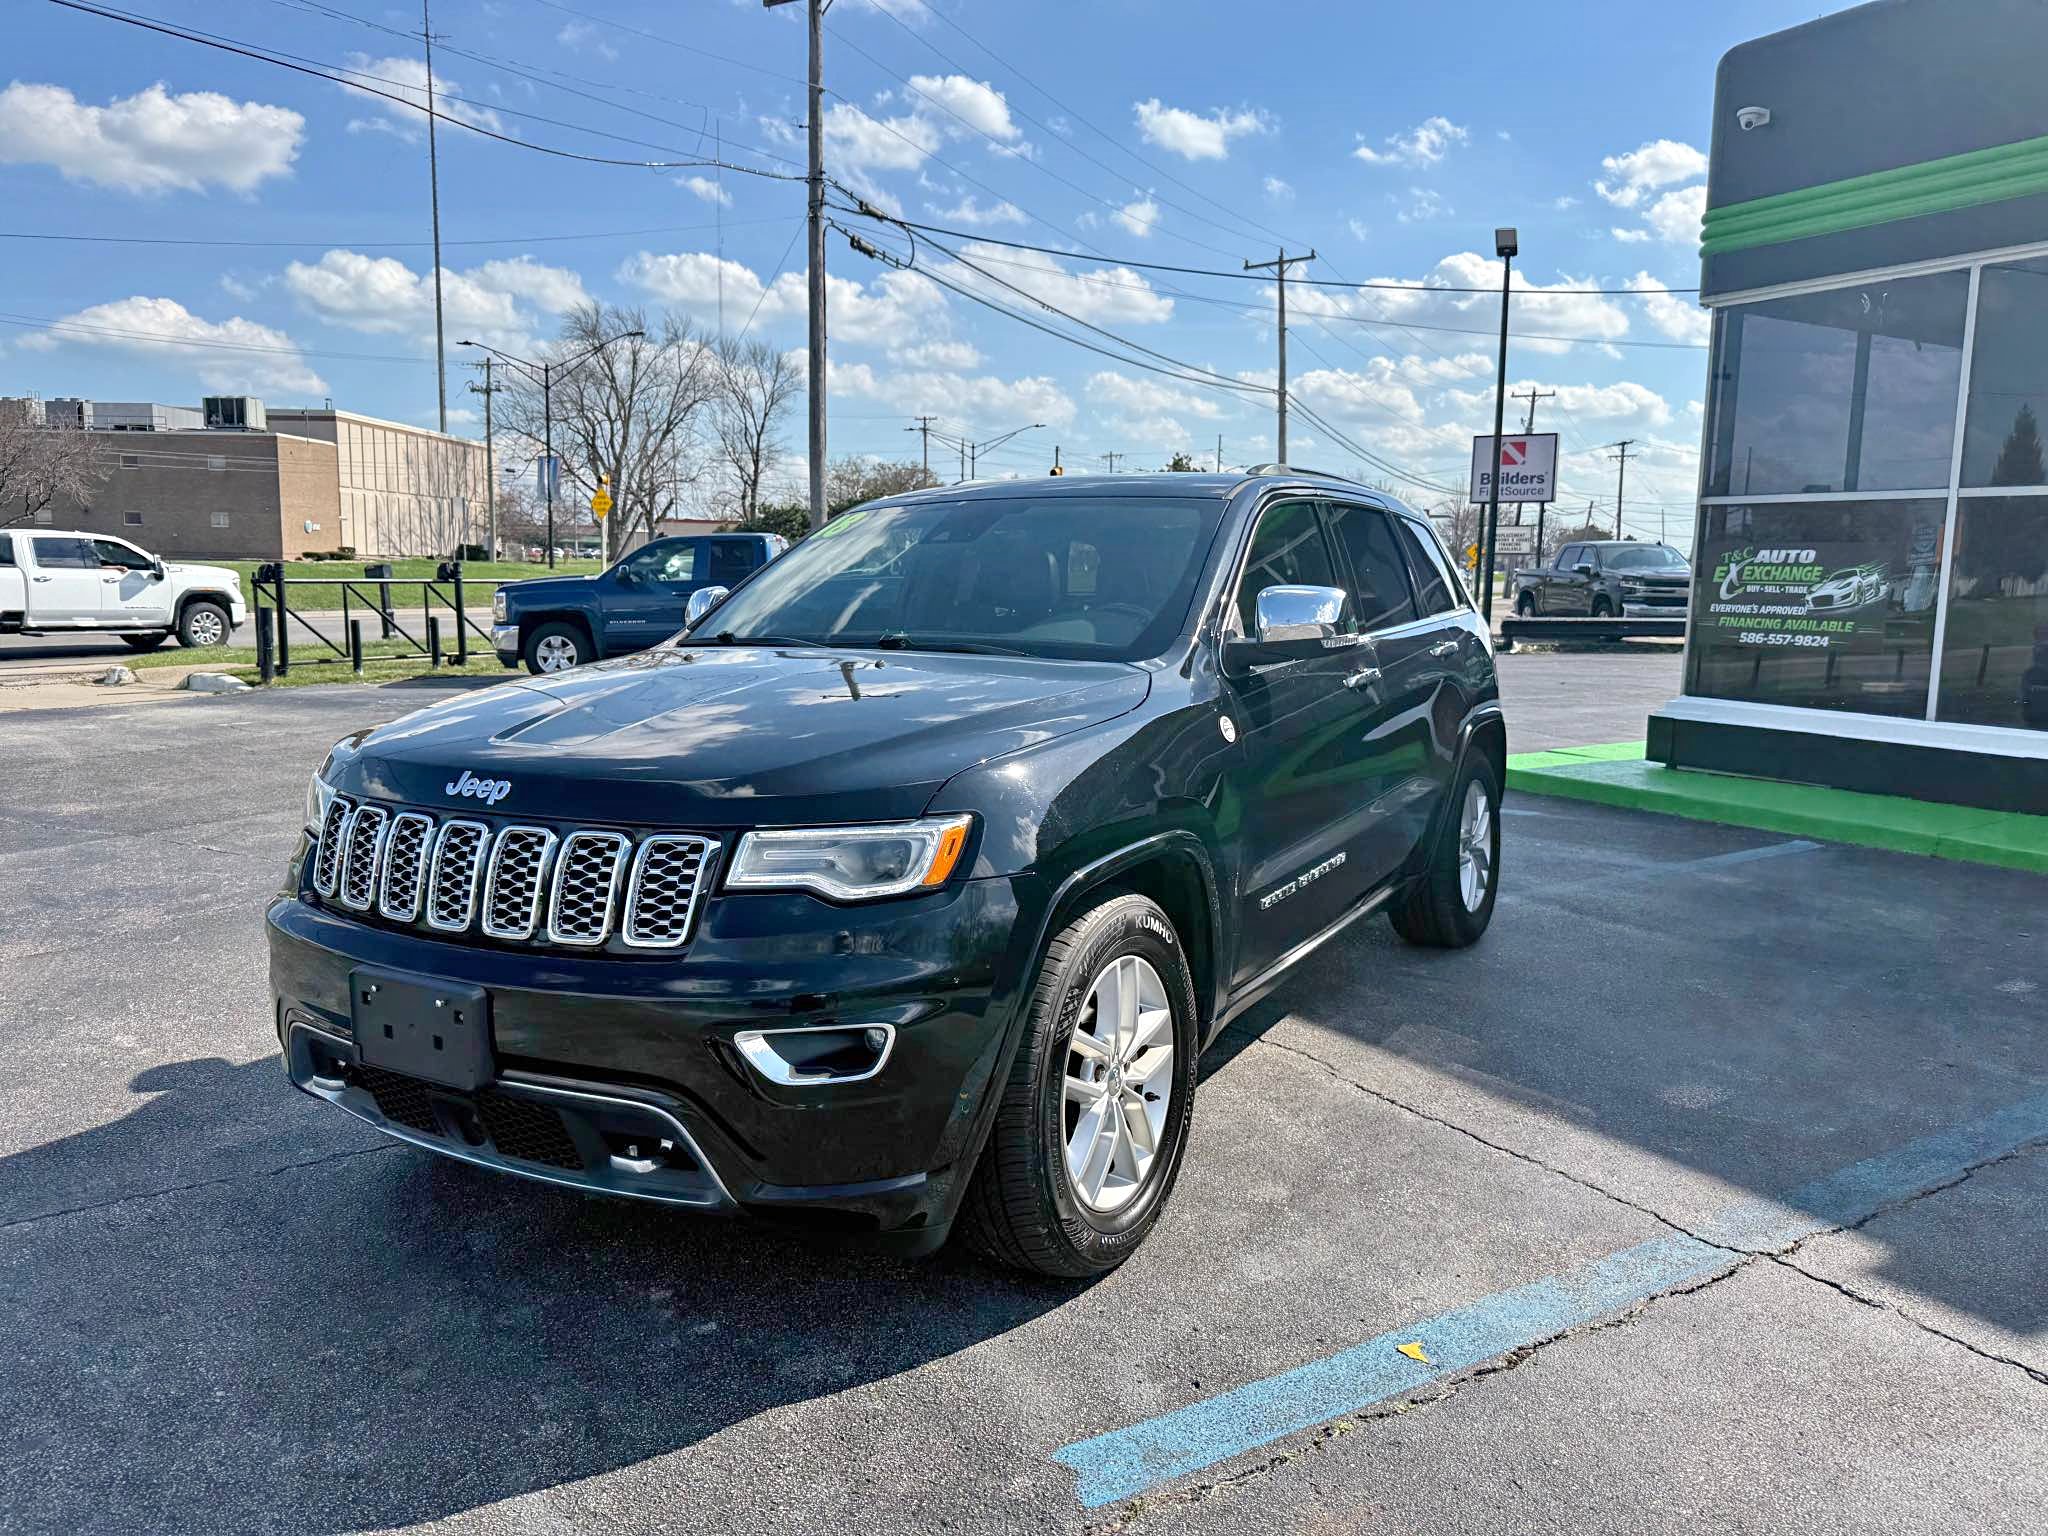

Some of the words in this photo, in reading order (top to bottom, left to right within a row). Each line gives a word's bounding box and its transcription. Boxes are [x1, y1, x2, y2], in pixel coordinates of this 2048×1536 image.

[1480, 472, 1545, 485] Bilders
[1479, 486, 1545, 496] FitSource
[1721, 546, 1754, 563] T&C
[1754, 549, 1816, 563] AUTO
[1742, 565, 1824, 582] EXCHANGE
[1746, 584, 1761, 593] BUY
[1764, 585, 1780, 593] SELL
[1710, 603, 1758, 614] EVERYONE'S
[1759, 605, 1808, 616] APPROVED!
[1718, 616, 1782, 630] FINANCING
[1784, 619, 1855, 633] AVAILABLE
[445, 770, 512, 806] Jeep
[1135, 915, 1173, 944] KUMHO
